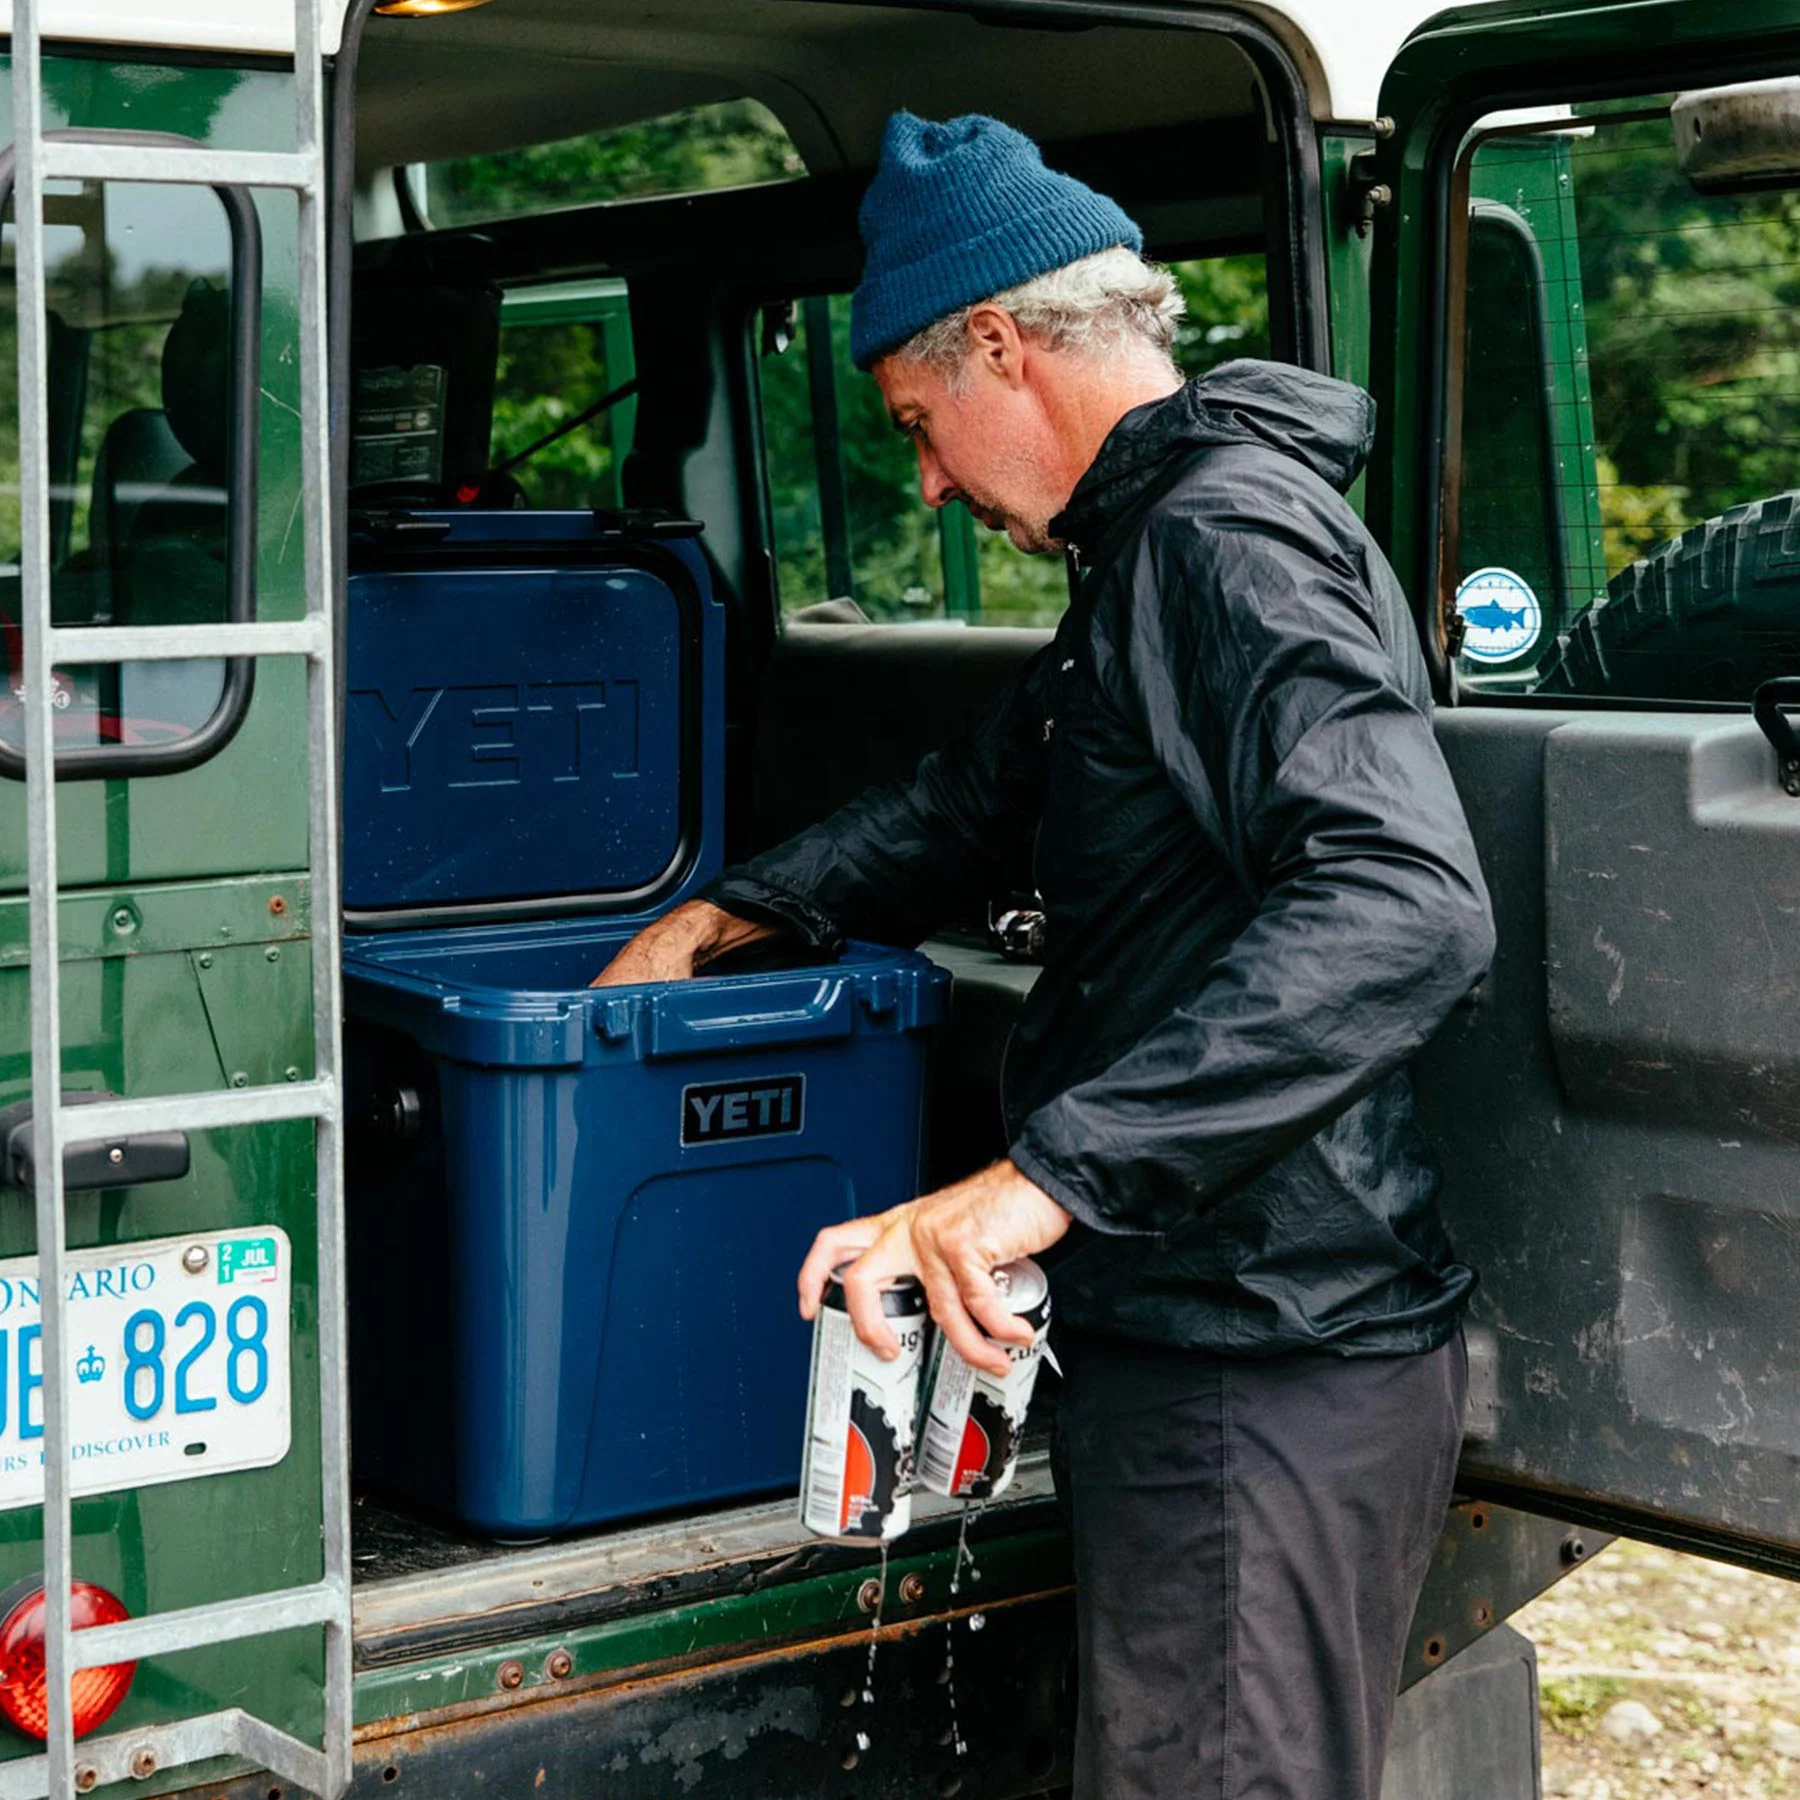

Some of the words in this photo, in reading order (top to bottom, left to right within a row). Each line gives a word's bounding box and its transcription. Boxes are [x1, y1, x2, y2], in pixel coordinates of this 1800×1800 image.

[348, 679, 640, 792] YETI
[690, 1087, 793, 1133] YETI
[240, 1247, 269, 1266] JUL
[0, 1263, 156, 1315] NARIO
[124, 1294, 269, 1421] 828
[71, 1431, 170, 1460] DISCOVER
